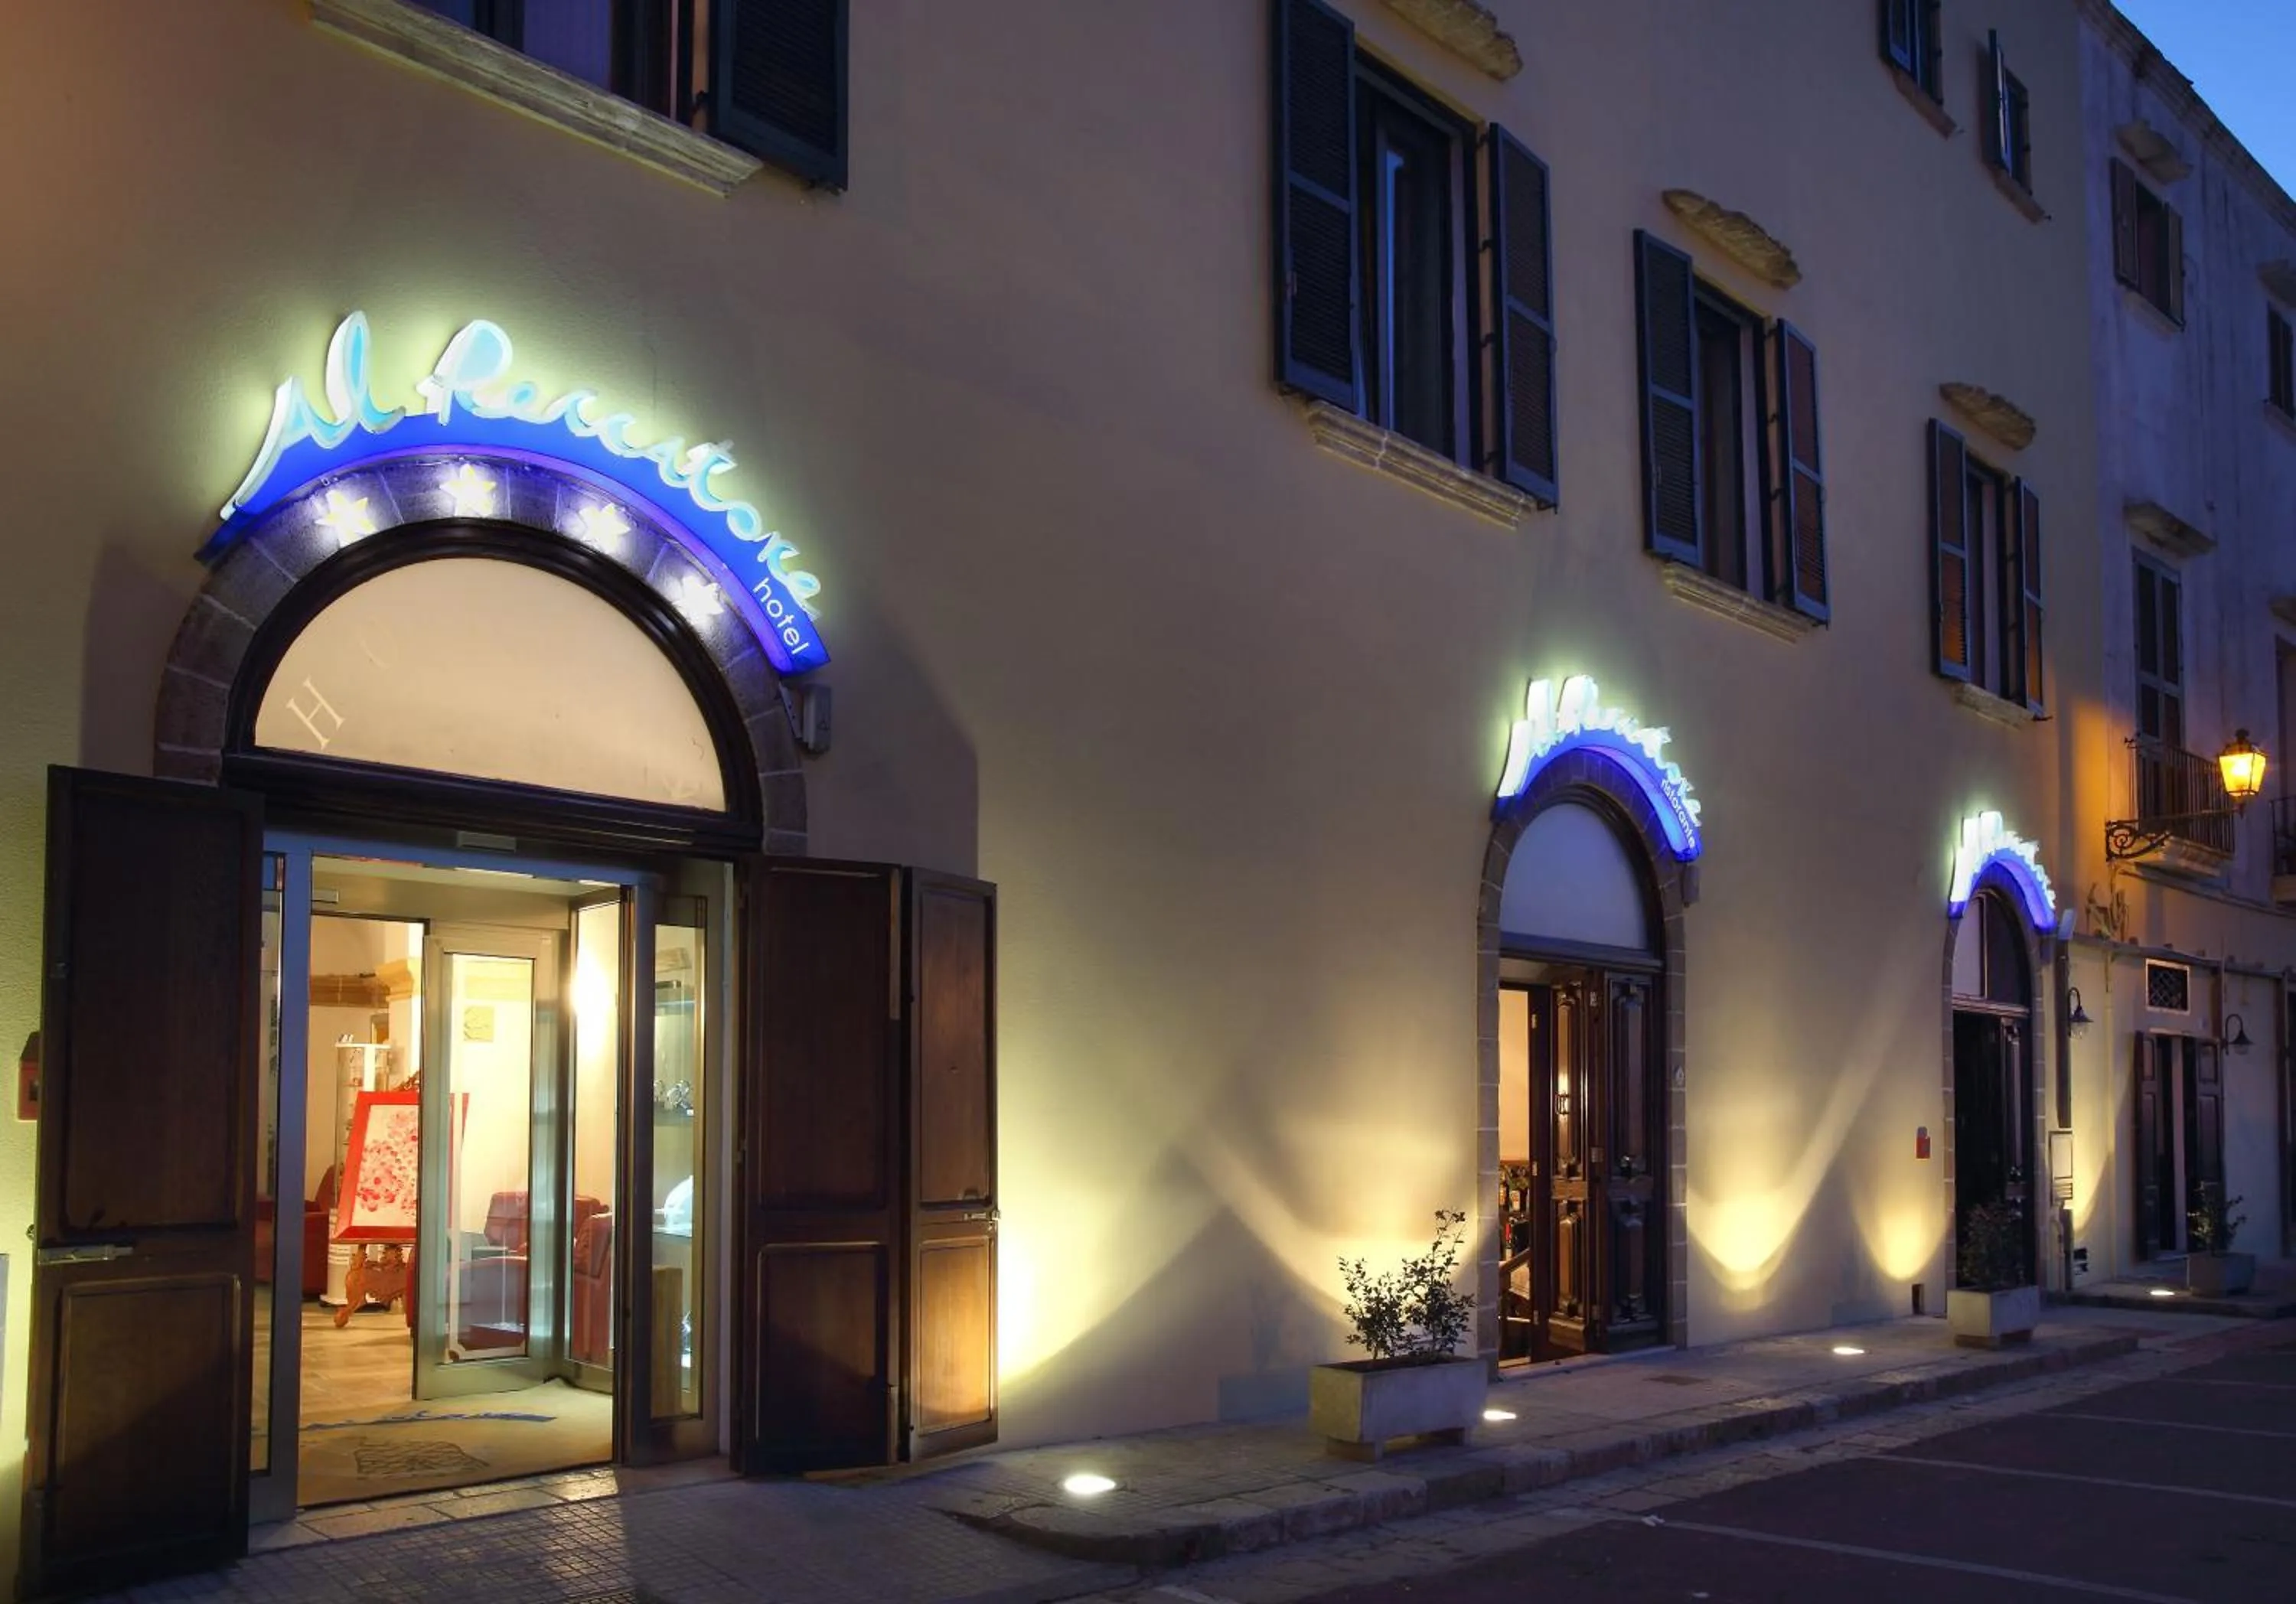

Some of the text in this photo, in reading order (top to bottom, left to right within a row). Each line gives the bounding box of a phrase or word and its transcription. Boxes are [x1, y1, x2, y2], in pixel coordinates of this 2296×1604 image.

[220, 310, 822, 621] Al Pescatore
[752, 578, 809, 654] hotel
